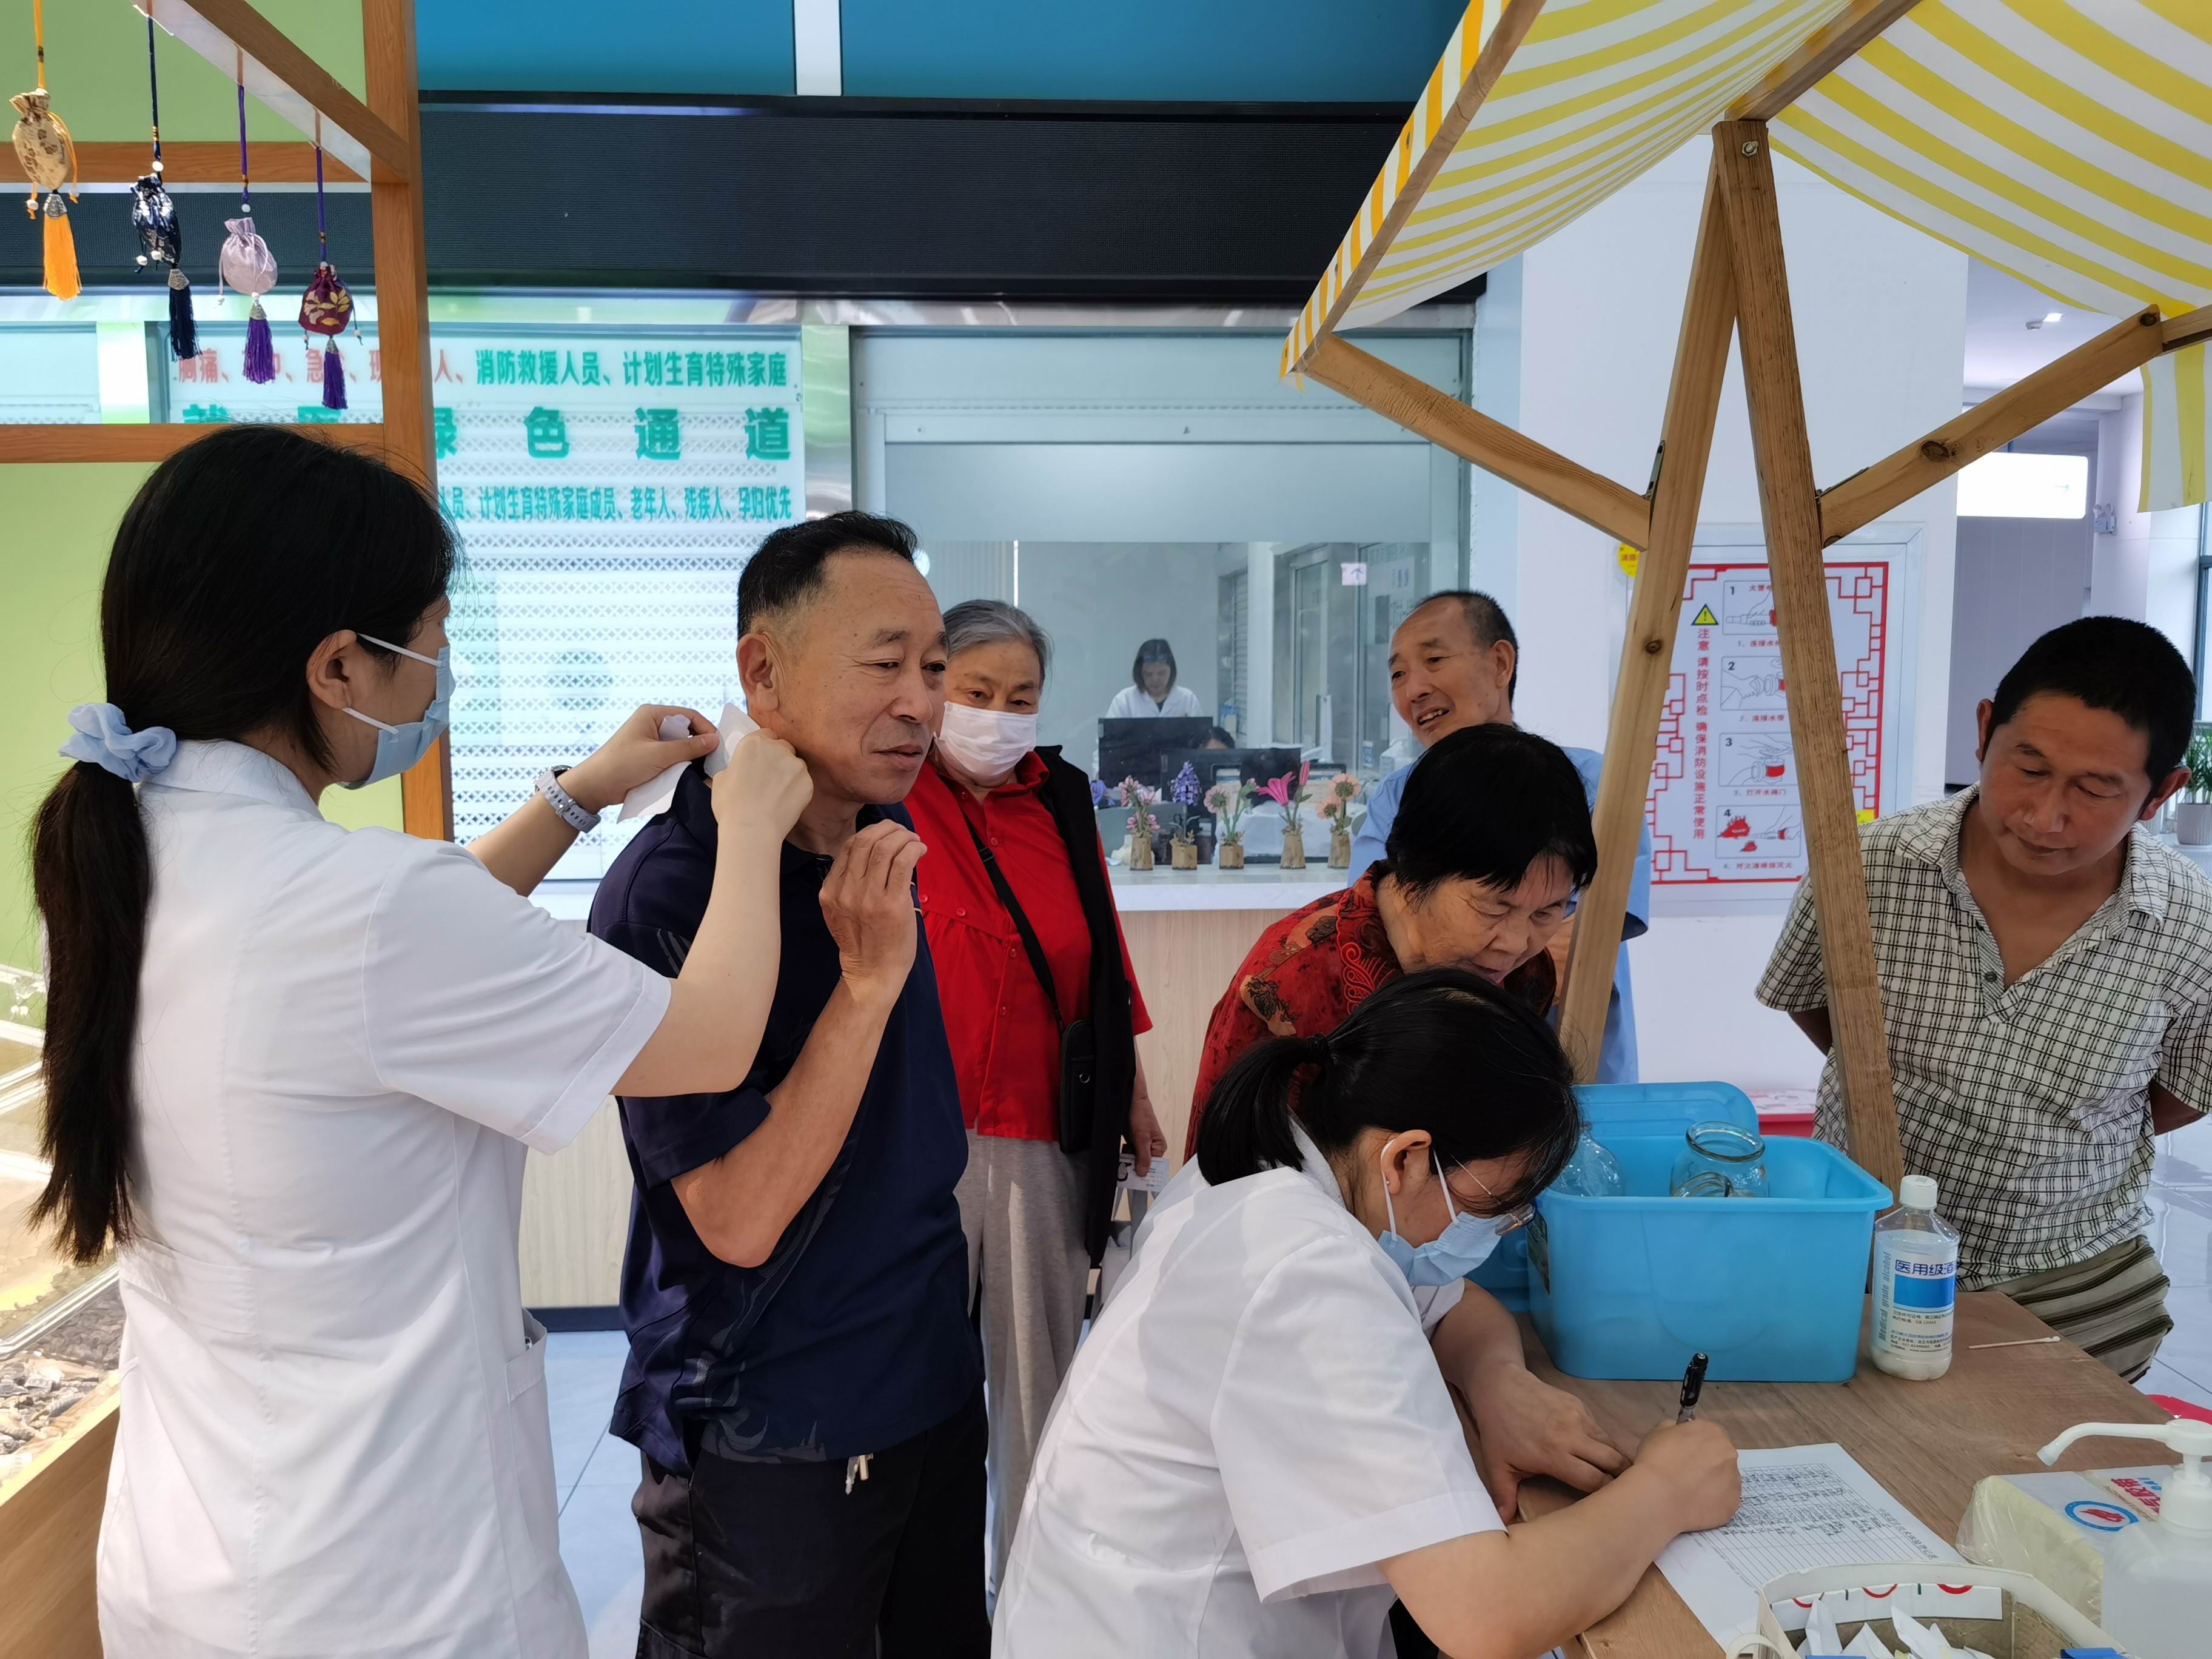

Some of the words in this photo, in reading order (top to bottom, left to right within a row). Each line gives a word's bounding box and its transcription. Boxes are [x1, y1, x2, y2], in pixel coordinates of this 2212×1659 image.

[1729, 586, 1735, 595] 1
[1728, 662, 1735, 671] 2
[1725, 737, 1732, 746] 3
[1723, 809, 1731, 817] 4
[1883, 1252, 1891, 1282] alcohol
[1879, 1309, 1888, 1341] Medical
